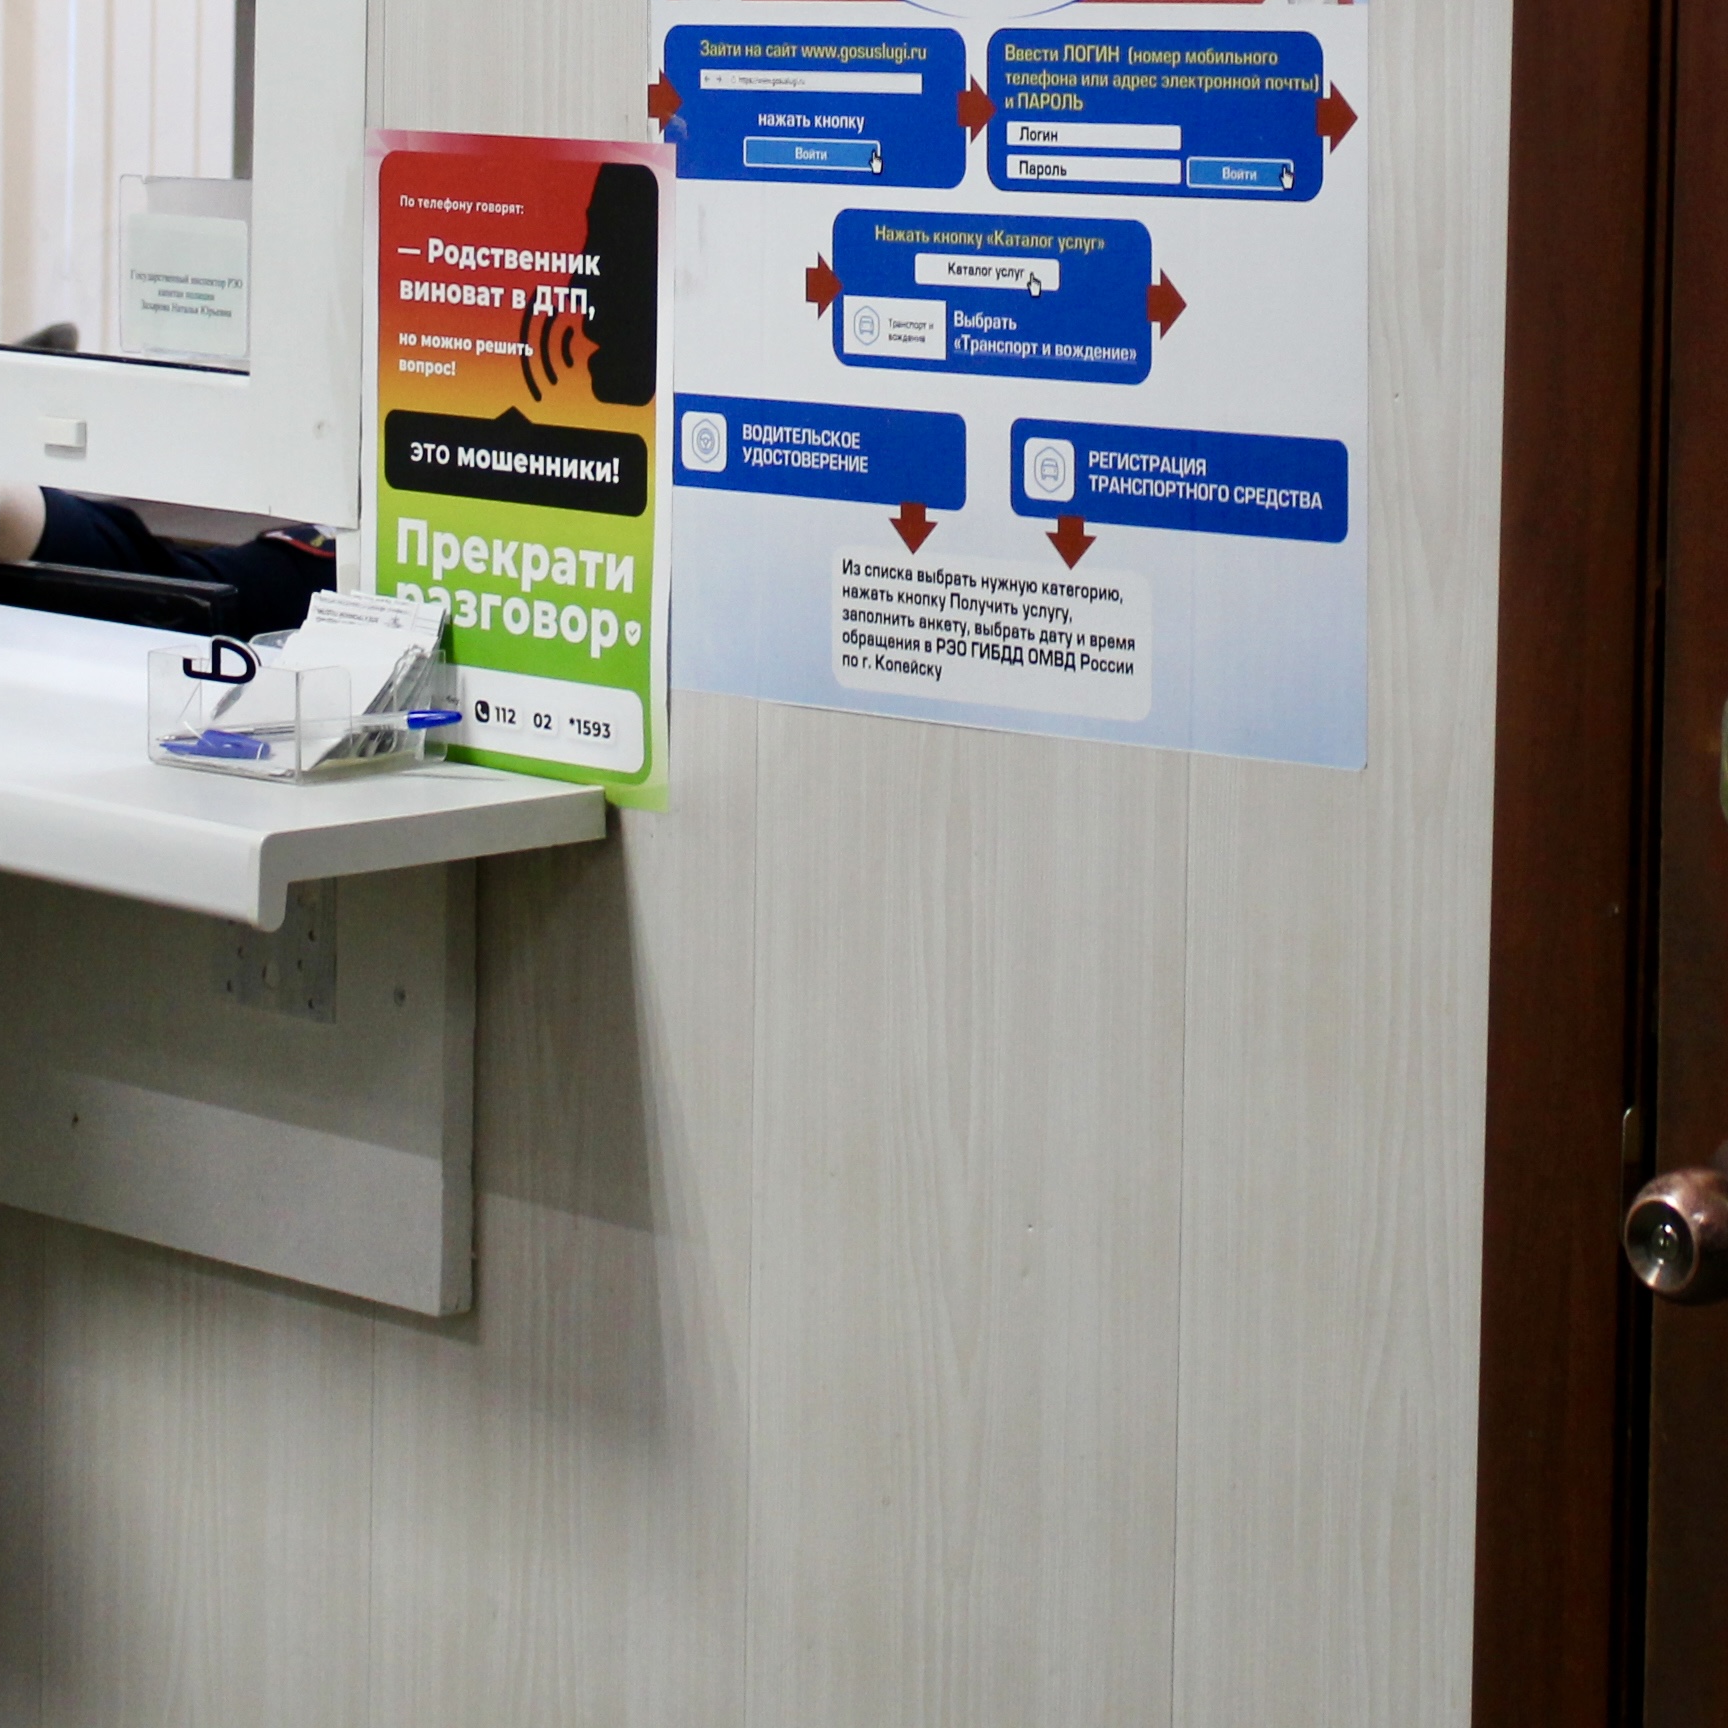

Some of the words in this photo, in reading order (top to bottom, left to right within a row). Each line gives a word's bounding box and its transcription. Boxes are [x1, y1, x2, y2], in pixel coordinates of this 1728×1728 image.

[1004, 43, 1059, 62] Ввести
[1062, 44, 1120, 63] ЛОГИН
[1128, 46, 1181, 67] (номер
[1185, 47, 1278, 66] мобильного
[1019, 125, 1058, 142] Логин
[1017, 159, 1067, 180] Пароль
[1222, 166, 1258, 181] Войти
[400, 194, 416, 208] По
[417, 197, 474, 214] телефону
[476, 201, 524, 216] говорят:
[428, 237, 600, 276] Родственник
[400, 280, 504, 307] виноват
[512, 287, 529, 312] в
[532, 284, 595, 321] ДТП,
[398, 332, 417, 346] но
[420, 334, 472, 351] можно
[475, 339, 534, 357] решить
[398, 358, 456, 378] вопрос!
[742, 423, 860, 449] ВОДИТЕЛЬСКОЕ
[410, 441, 450, 465] это
[457, 446, 620, 484] мошенники!
[742, 446, 868, 473] УДОСТОВЕРЕНИЕ
[1089, 450, 1207, 478] РЕГИСТРАЦИЯ
[1088, 473, 1230, 503] ТРАНСПОРТНОГО
[1233, 485, 1323, 510] СРЕДСТВА
[397, 516, 635, 594] Прекрати
[842, 558, 861, 576] Из
[864, 564, 913, 582] списка
[917, 568, 977, 590] выбрать
[981, 576, 1038, 597] нужную
[1041, 582, 1123, 605] категорию,
[842, 585, 894, 603] нажать
[897, 591, 946, 613] кнопку
[950, 593, 1019, 617] Получить
[1022, 603, 1073, 625] услугу,
[495, 706, 517, 725] 112
[533, 712, 552, 731] 02
